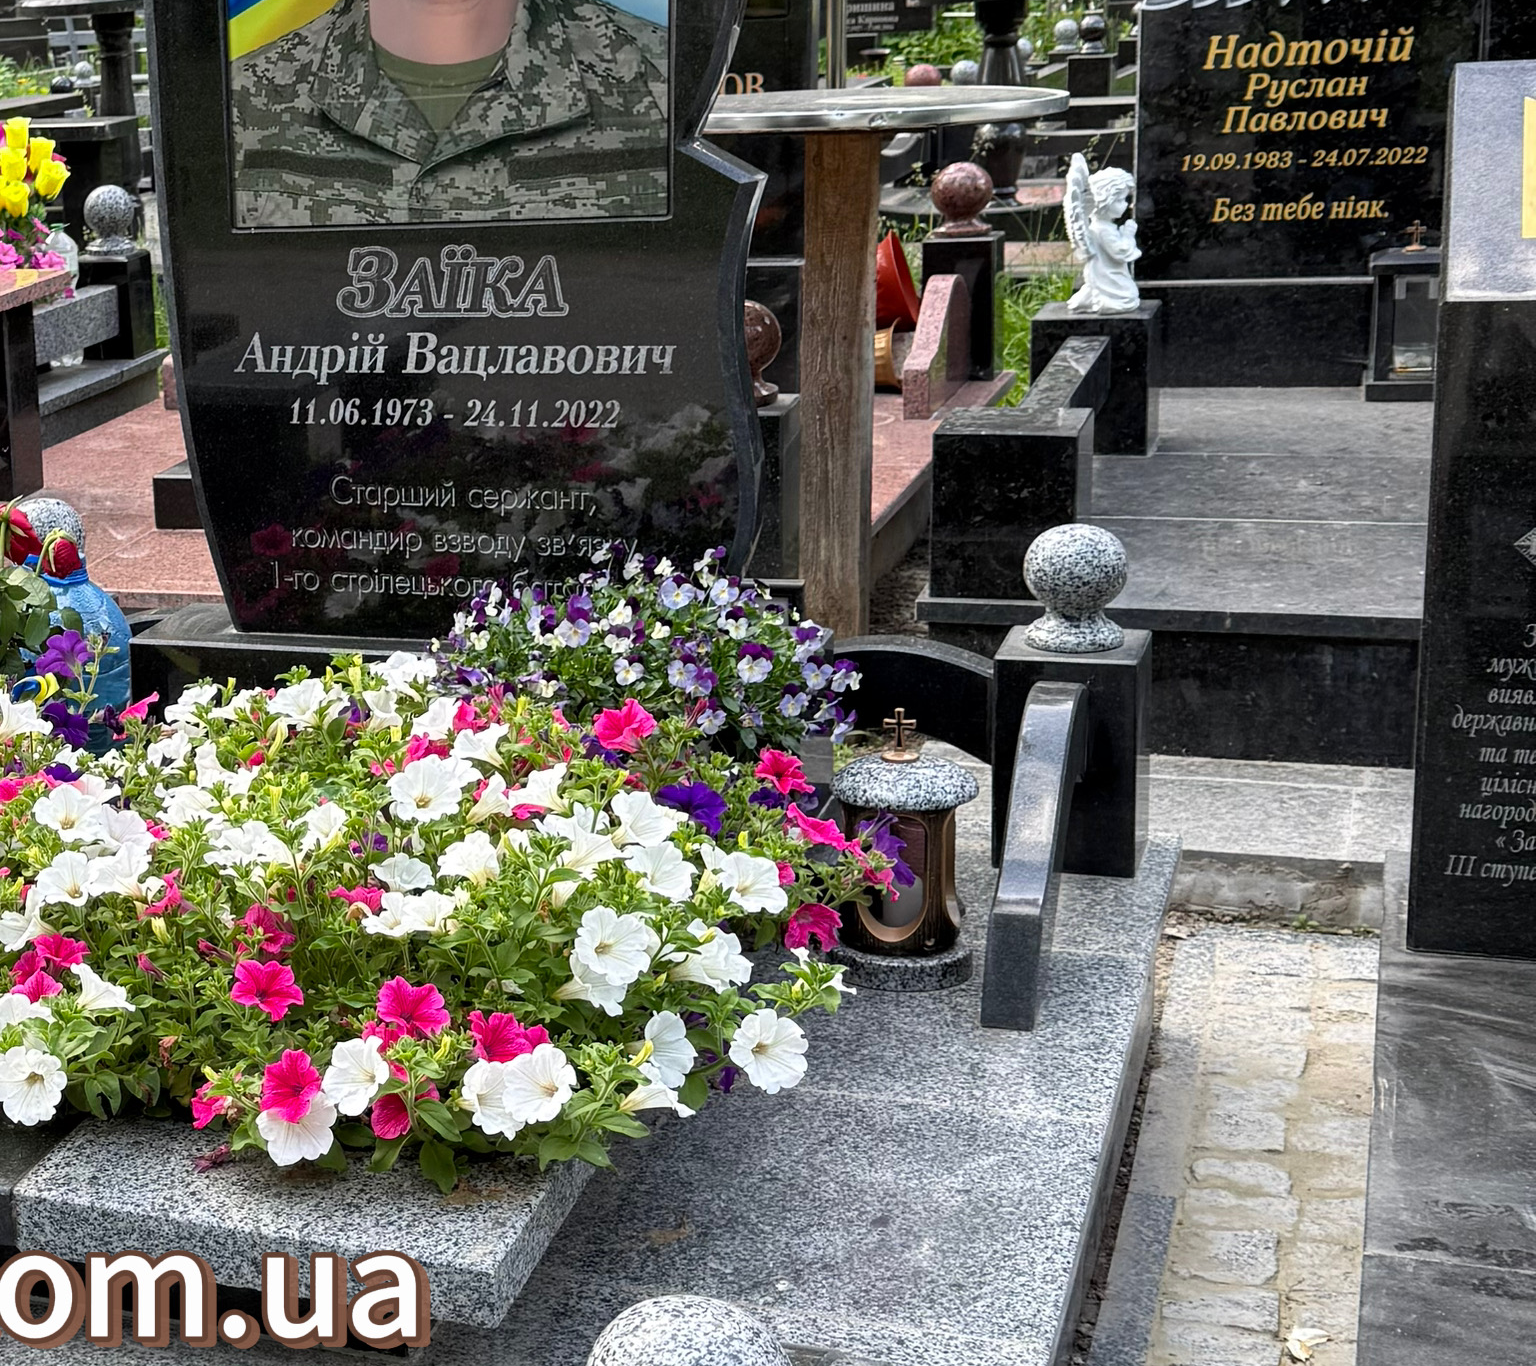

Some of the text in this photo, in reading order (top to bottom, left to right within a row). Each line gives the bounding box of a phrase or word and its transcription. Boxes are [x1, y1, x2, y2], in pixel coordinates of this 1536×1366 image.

[1201, 25, 1416, 71] Надточій
[1241, 72, 1370, 109] Руслан
[1220, 105, 1390, 135] Павлович
[1180, 150, 1294, 173] 19.09.1983
[1309, 145, 1430, 169] 24.07.2022
[1210, 191, 1391, 224] Без тебе ніяк.
[335, 243, 570, 319] ЗАЇКА
[233, 330, 678, 386] Андрій Вацлавович
[288, 396, 435, 427] 11.06.1973
[463, 398, 622, 429] 24.11.2022
[329, 473, 599, 517] Старший сержант,
[290, 527, 424, 561] командир
[433, 532, 527, 563] взводу
[269, 560, 320, 592] 1-го
[1478, 745, 1508, 763] та
